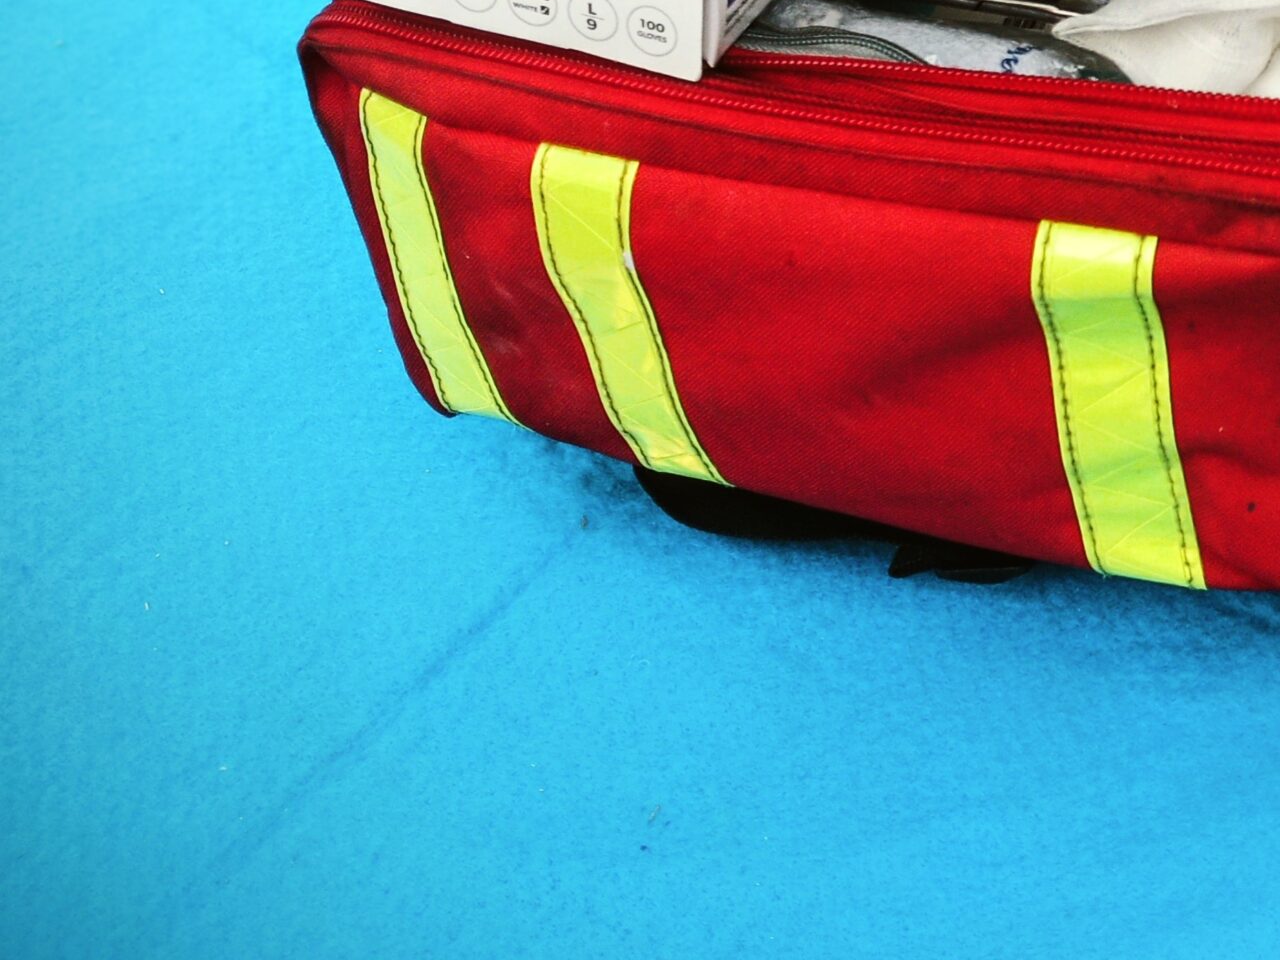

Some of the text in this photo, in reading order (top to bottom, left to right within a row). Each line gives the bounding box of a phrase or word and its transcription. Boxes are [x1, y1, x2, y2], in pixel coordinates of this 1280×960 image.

[587, 2, 597, 15] L
[586, 18, 597, 30] 9
[640, 18, 665, 33] 100
[636, 30, 668, 44] GLOVES
